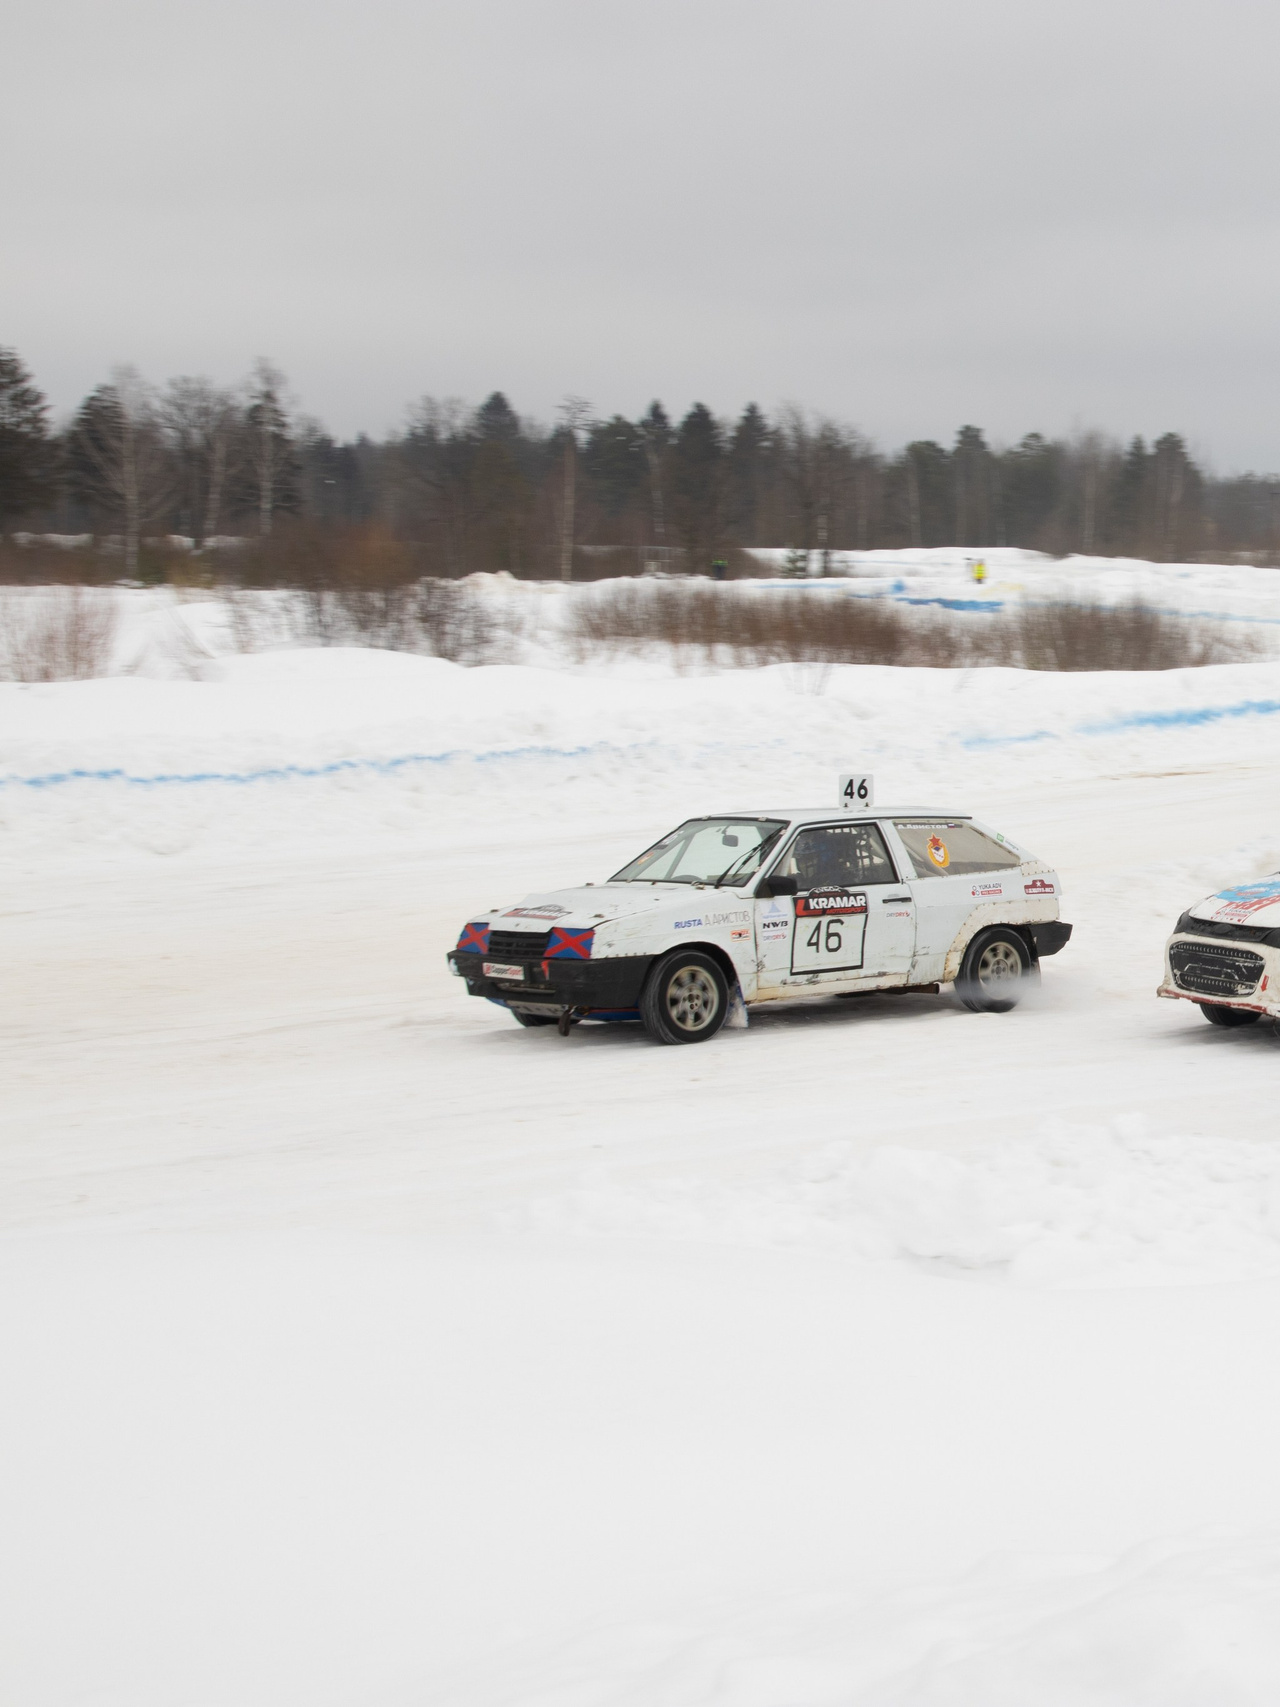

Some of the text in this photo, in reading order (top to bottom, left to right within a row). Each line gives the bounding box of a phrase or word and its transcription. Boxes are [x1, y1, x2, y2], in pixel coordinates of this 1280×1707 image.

[843, 778, 868, 800] 46
[809, 896, 866, 910] KRAMAR
[674, 919, 703, 929] RUSTA
[763, 921, 788, 929] NWB
[807, 918, 844, 953] 46
